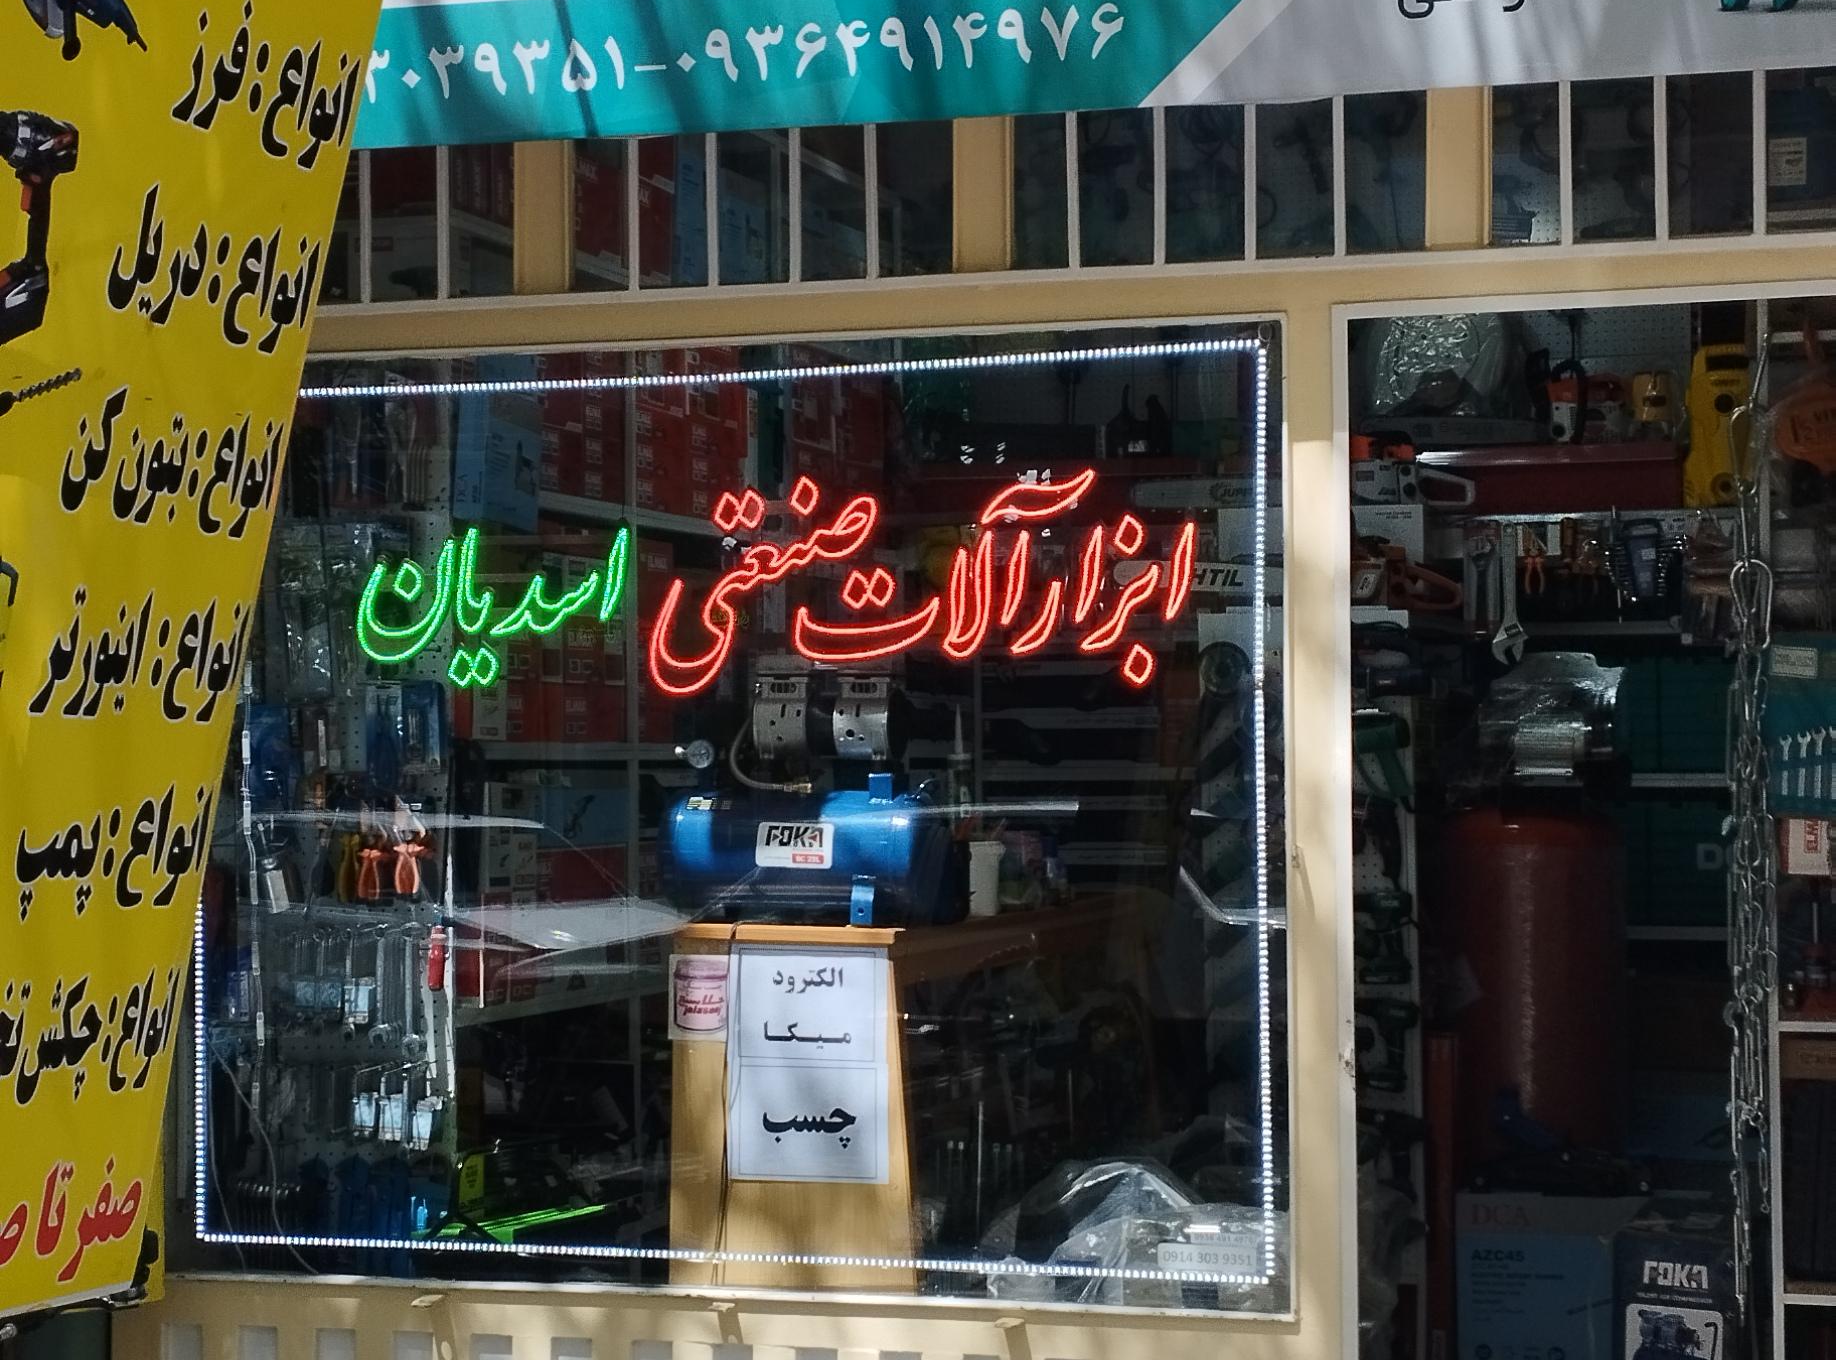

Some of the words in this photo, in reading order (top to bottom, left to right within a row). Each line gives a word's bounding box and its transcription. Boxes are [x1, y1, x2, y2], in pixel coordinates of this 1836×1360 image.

[355, 525, 630, 690] اسدیان
[648, 474, 881, 698] صنعتی
[792, 467, 1097, 663] آلات
[1010, 512, 1196, 690] ابزار
[16, 813, 101, 923] پمپ
[763, 1020, 852, 1051] میکا
[772, 966, 845, 993] الکترود
[15, 975, 103, 1106] چکش
[762, 1102, 857, 1149] چسب
[36, 1163, 75, 1257] تا
[57, 1155, 143, 1282] صفر
[1197, 1253, 1218, 1265] 303
[1222, 1253, 1253, 1267] 9351
